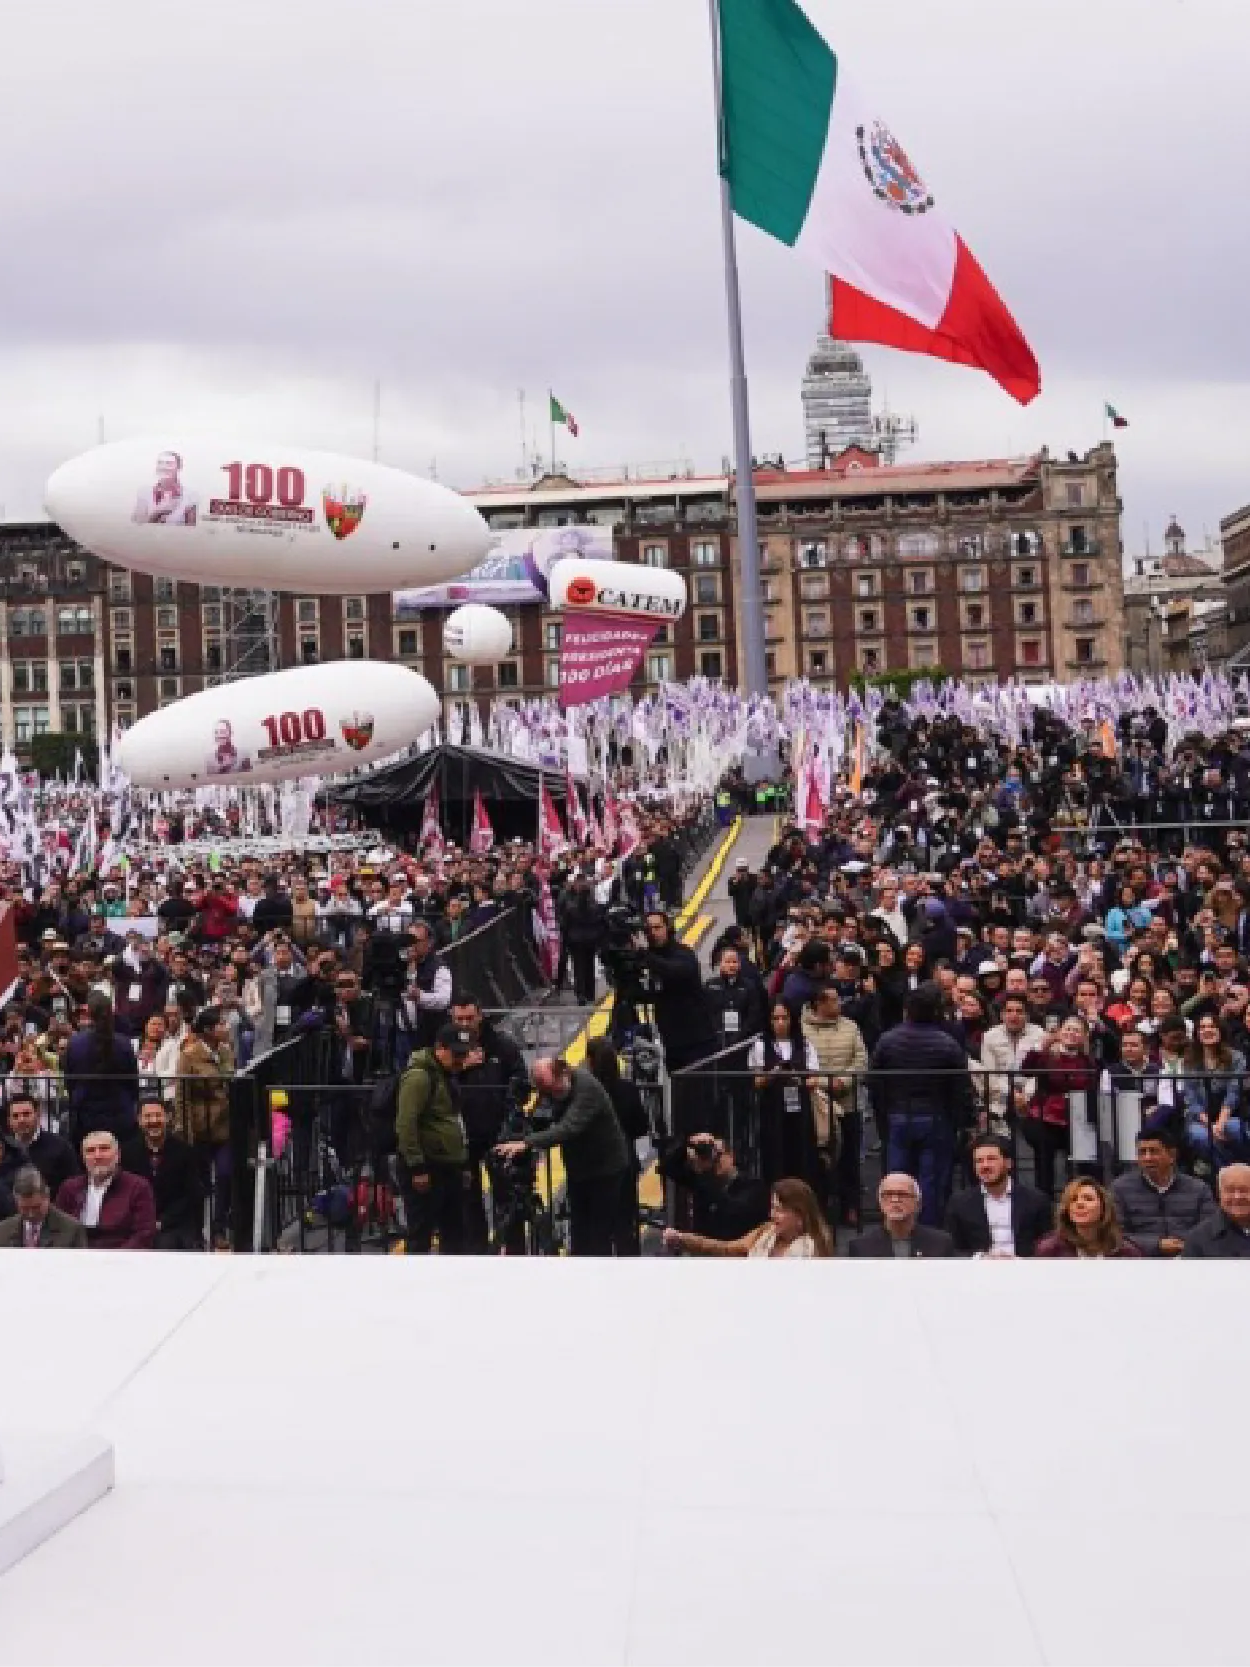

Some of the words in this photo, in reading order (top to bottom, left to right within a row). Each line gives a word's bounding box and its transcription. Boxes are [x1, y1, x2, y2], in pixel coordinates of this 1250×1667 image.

[220, 461, 306, 507] 100
[597, 588, 682, 615] CATEM
[261, 708, 326, 748] 100
